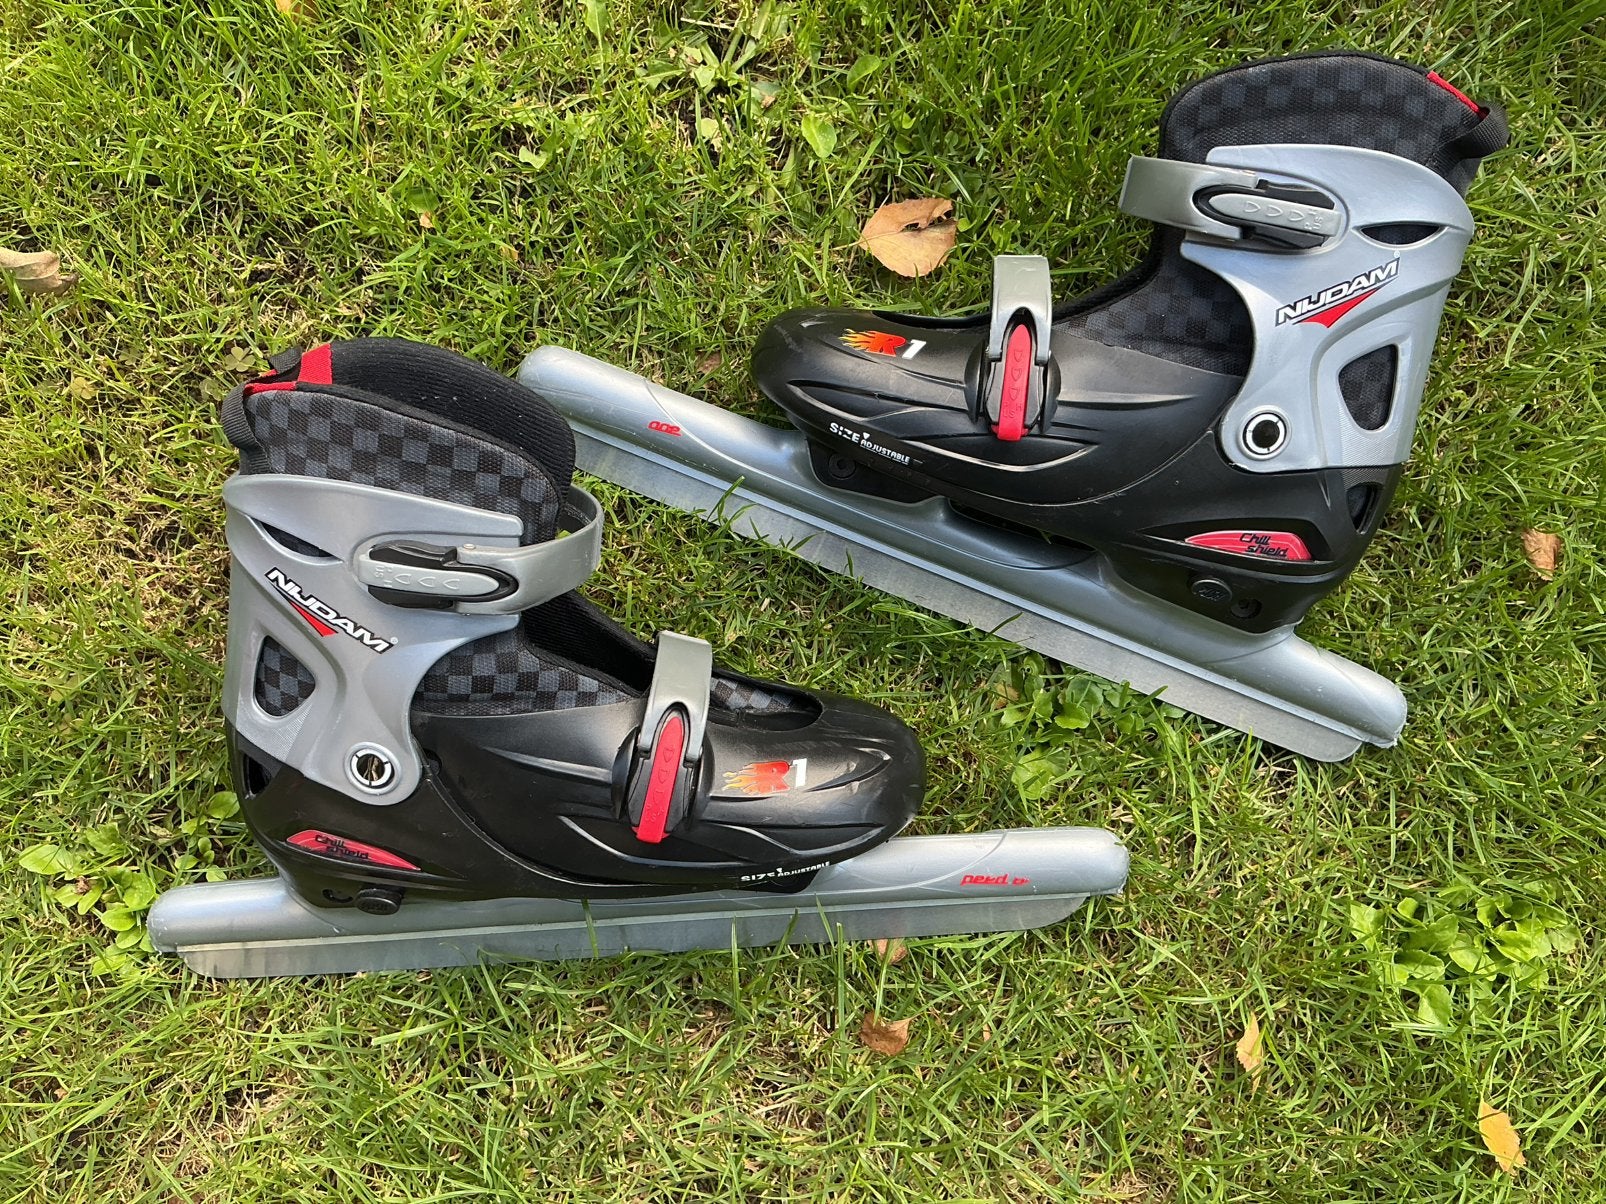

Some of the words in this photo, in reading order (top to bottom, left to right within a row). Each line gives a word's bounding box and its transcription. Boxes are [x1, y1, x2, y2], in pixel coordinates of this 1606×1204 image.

[1276, 258, 1400, 326] NIJDAM
[829, 422, 861, 444] SIZE
[860, 439, 911, 464] ADJUSTABLE
[1240, 532, 1271, 546] Chill
[1245, 545, 1289, 558] shield
[265, 567, 394, 654] NIJDAM
